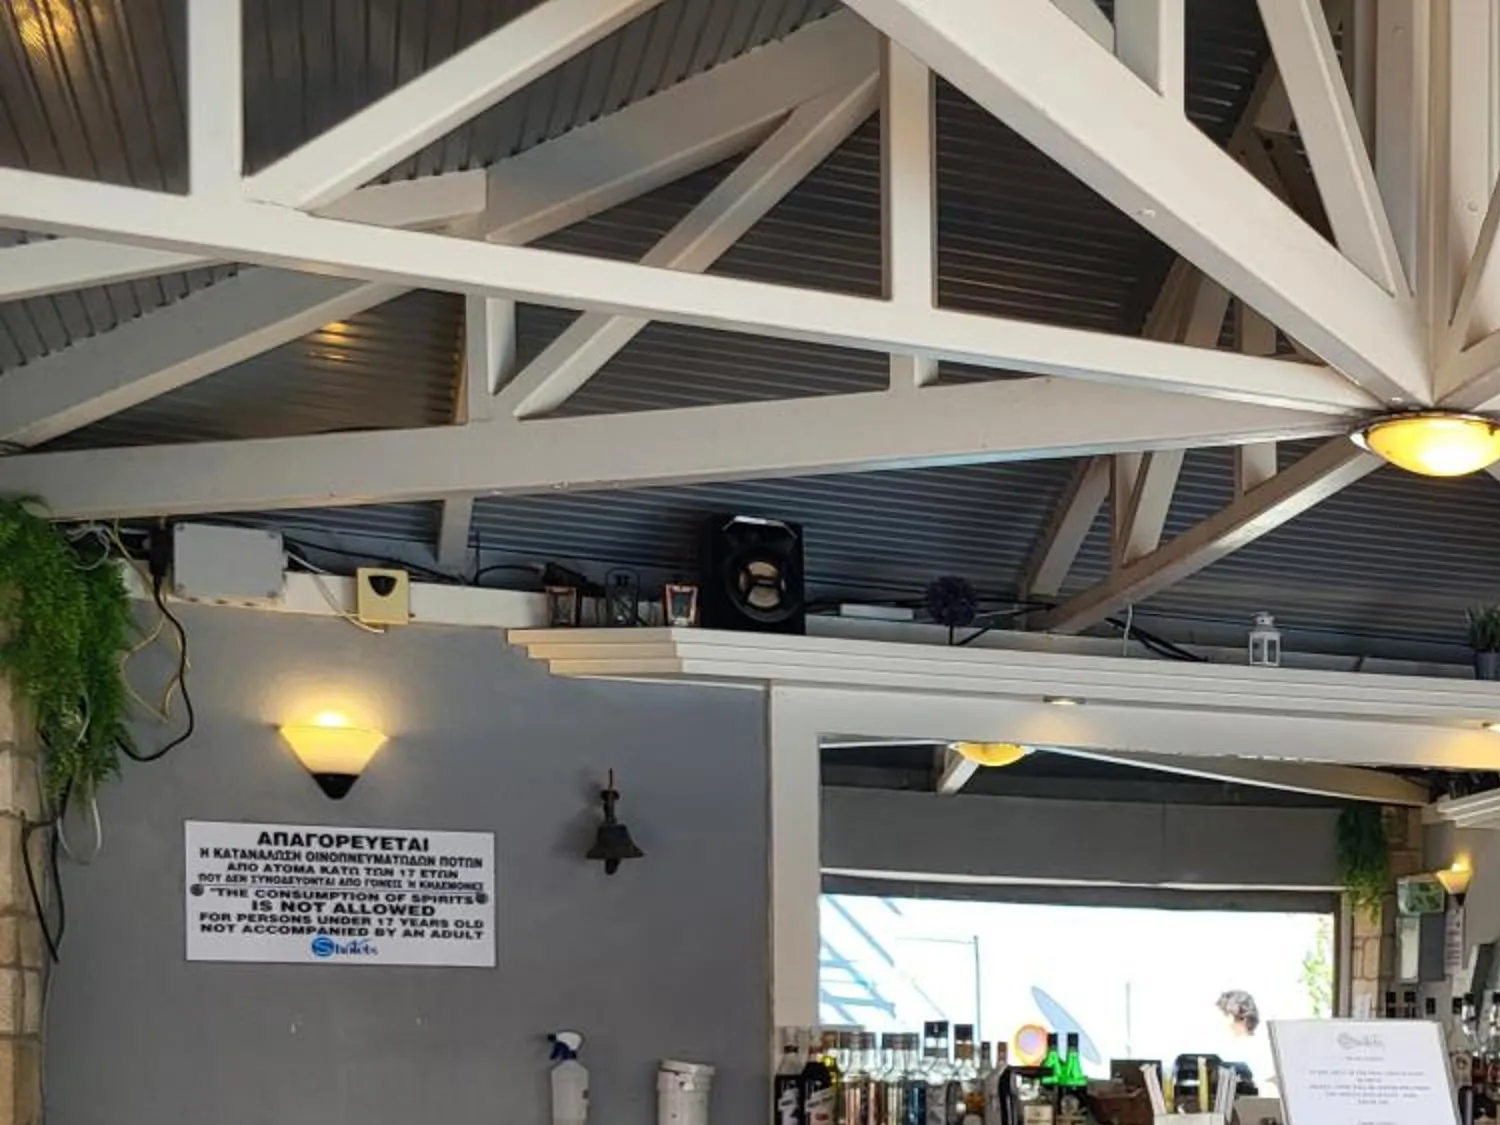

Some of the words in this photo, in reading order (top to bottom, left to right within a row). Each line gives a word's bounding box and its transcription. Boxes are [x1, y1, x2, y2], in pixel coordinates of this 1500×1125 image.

[257, 831, 429, 852] ΑΠΑΓΟΡΕΥΕΤΑΙ
[199, 848, 210, 858] Η
[213, 848, 302, 862] ΚΑΤΑΝΑΛΩΣΗ
[305, 851, 436, 867] ΟΙΝΟΠΝΕΥΜΑΤΩΔΩΝ
[439, 857, 483, 868] ΠΟΤΩΝ
[227, 863, 259, 872] ΑΠΟ
[263, 864, 315, 874] ΑΤΟΜΑ
[320, 866, 360, 876] ΚΑΤΩ
[365, 868, 395, 877] ΤΩΝ
[399, 869, 415, 878] 17
[420, 870, 459, 879] ΕΤΩΝ
[198, 874, 222, 883] ΠΟΥ
[225, 875, 248, 883] ΔΕΝ
[250, 875, 336, 886] ΣΥΝΟΔΕΥΟΝΤΑΙ
[337, 878, 361, 887] ΑΠΟ
[364, 879, 403, 889] ΓΟΝΕΙΣ
[254, 889, 380, 901] CONSUMPTION
[384, 894, 407, 903] OF
[251, 900, 273, 912] IS
[280, 901, 326, 913] NOT
[332, 903, 436, 917] ALLOWED
[199, 912, 232, 922] FOR
[236, 913, 313, 924] PERSONS
[317, 915, 371, 926] UNDER
[377, 918, 393, 927] 17
[399, 918, 449, 928] YEARS
[453, 920, 485, 929] OLD
[200, 923, 236, 933] NOT
[242, 924, 370, 937] ACCOMPANIED
[375, 928, 397, 937] BY
[402, 929, 425, 938] AN
[430, 930, 486, 940] ADULT
